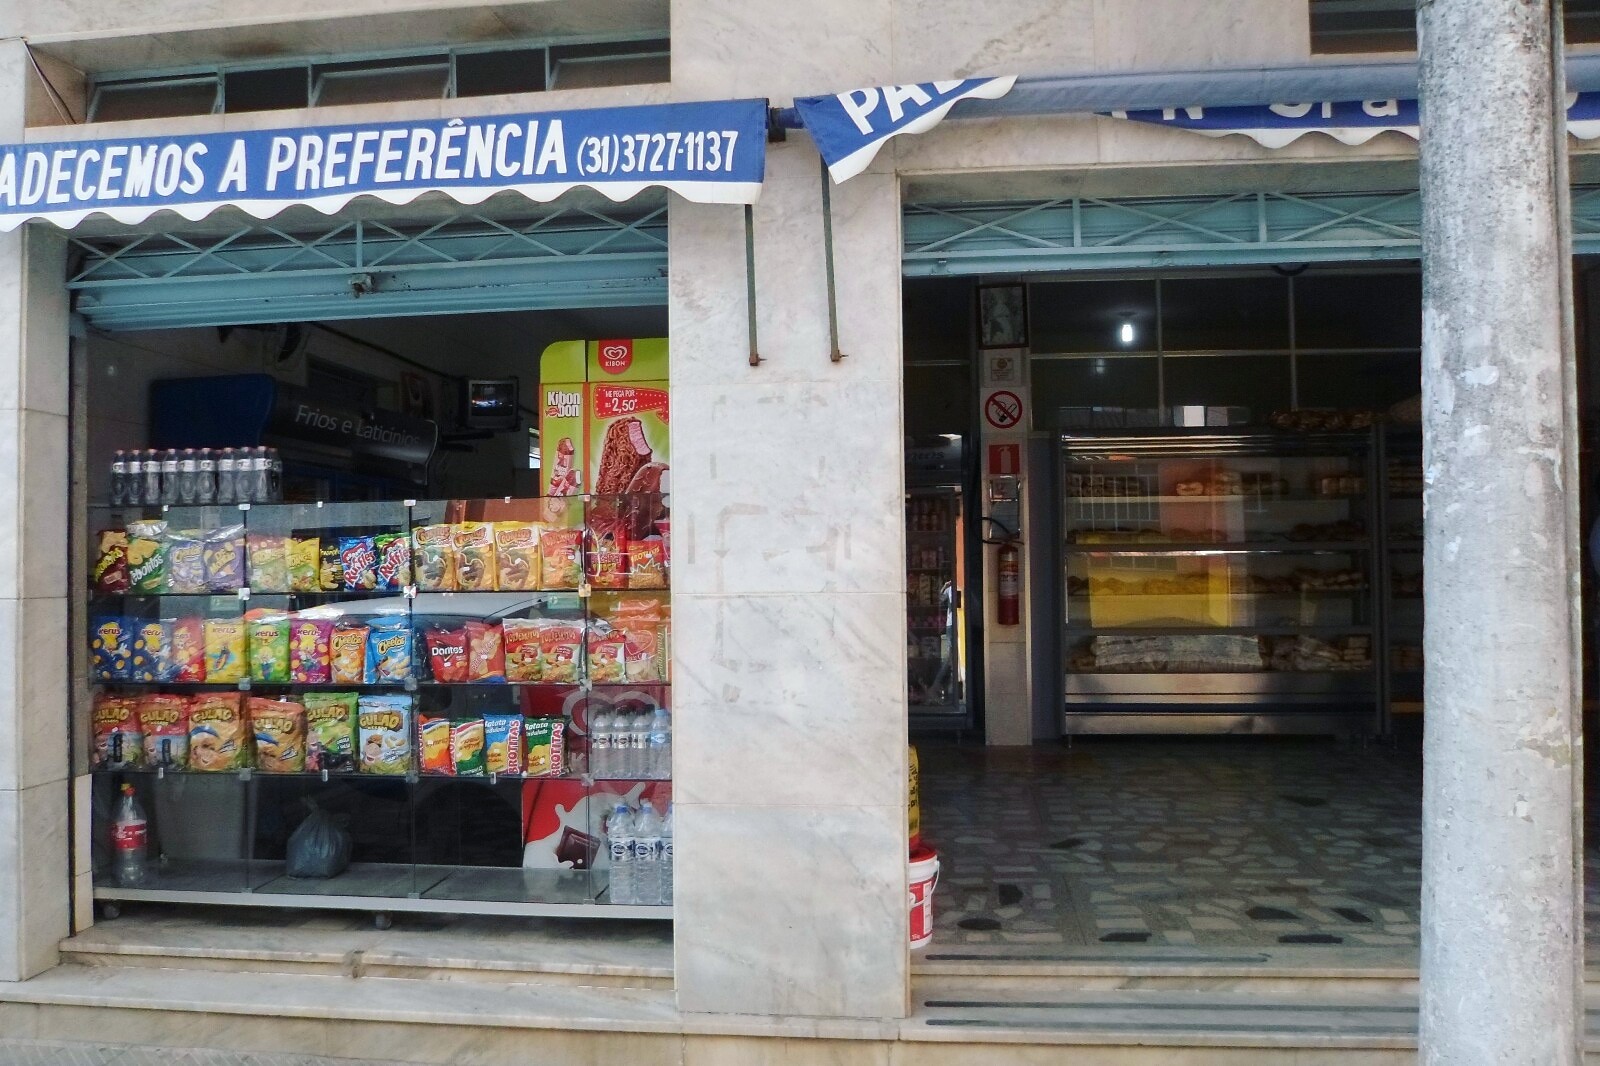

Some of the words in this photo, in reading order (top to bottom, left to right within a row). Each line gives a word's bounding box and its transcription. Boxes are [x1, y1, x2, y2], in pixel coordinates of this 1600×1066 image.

[217, 139, 247, 193] A
[266, 119, 567, 192] PREFERÊNCIA
[577, 131, 738, 176] (31)3727-1137
[547, 391, 581, 406] Kibon
[605, 390, 613, 398] ME
[625, 389, 636, 397] POR
[295, 404, 338, 430] Frios
[341, 419, 353, 433] e
[558, 404, 580, 417] bon
[344, 551, 376, 587] Ruffles
[332, 635, 363, 650] Cheetos
[378, 636, 405, 654] Cheetos
[431, 646, 464, 656] Doritos
[507, 719, 521, 775] BROTITAS
[550, 722, 564, 777] BROTITAS
